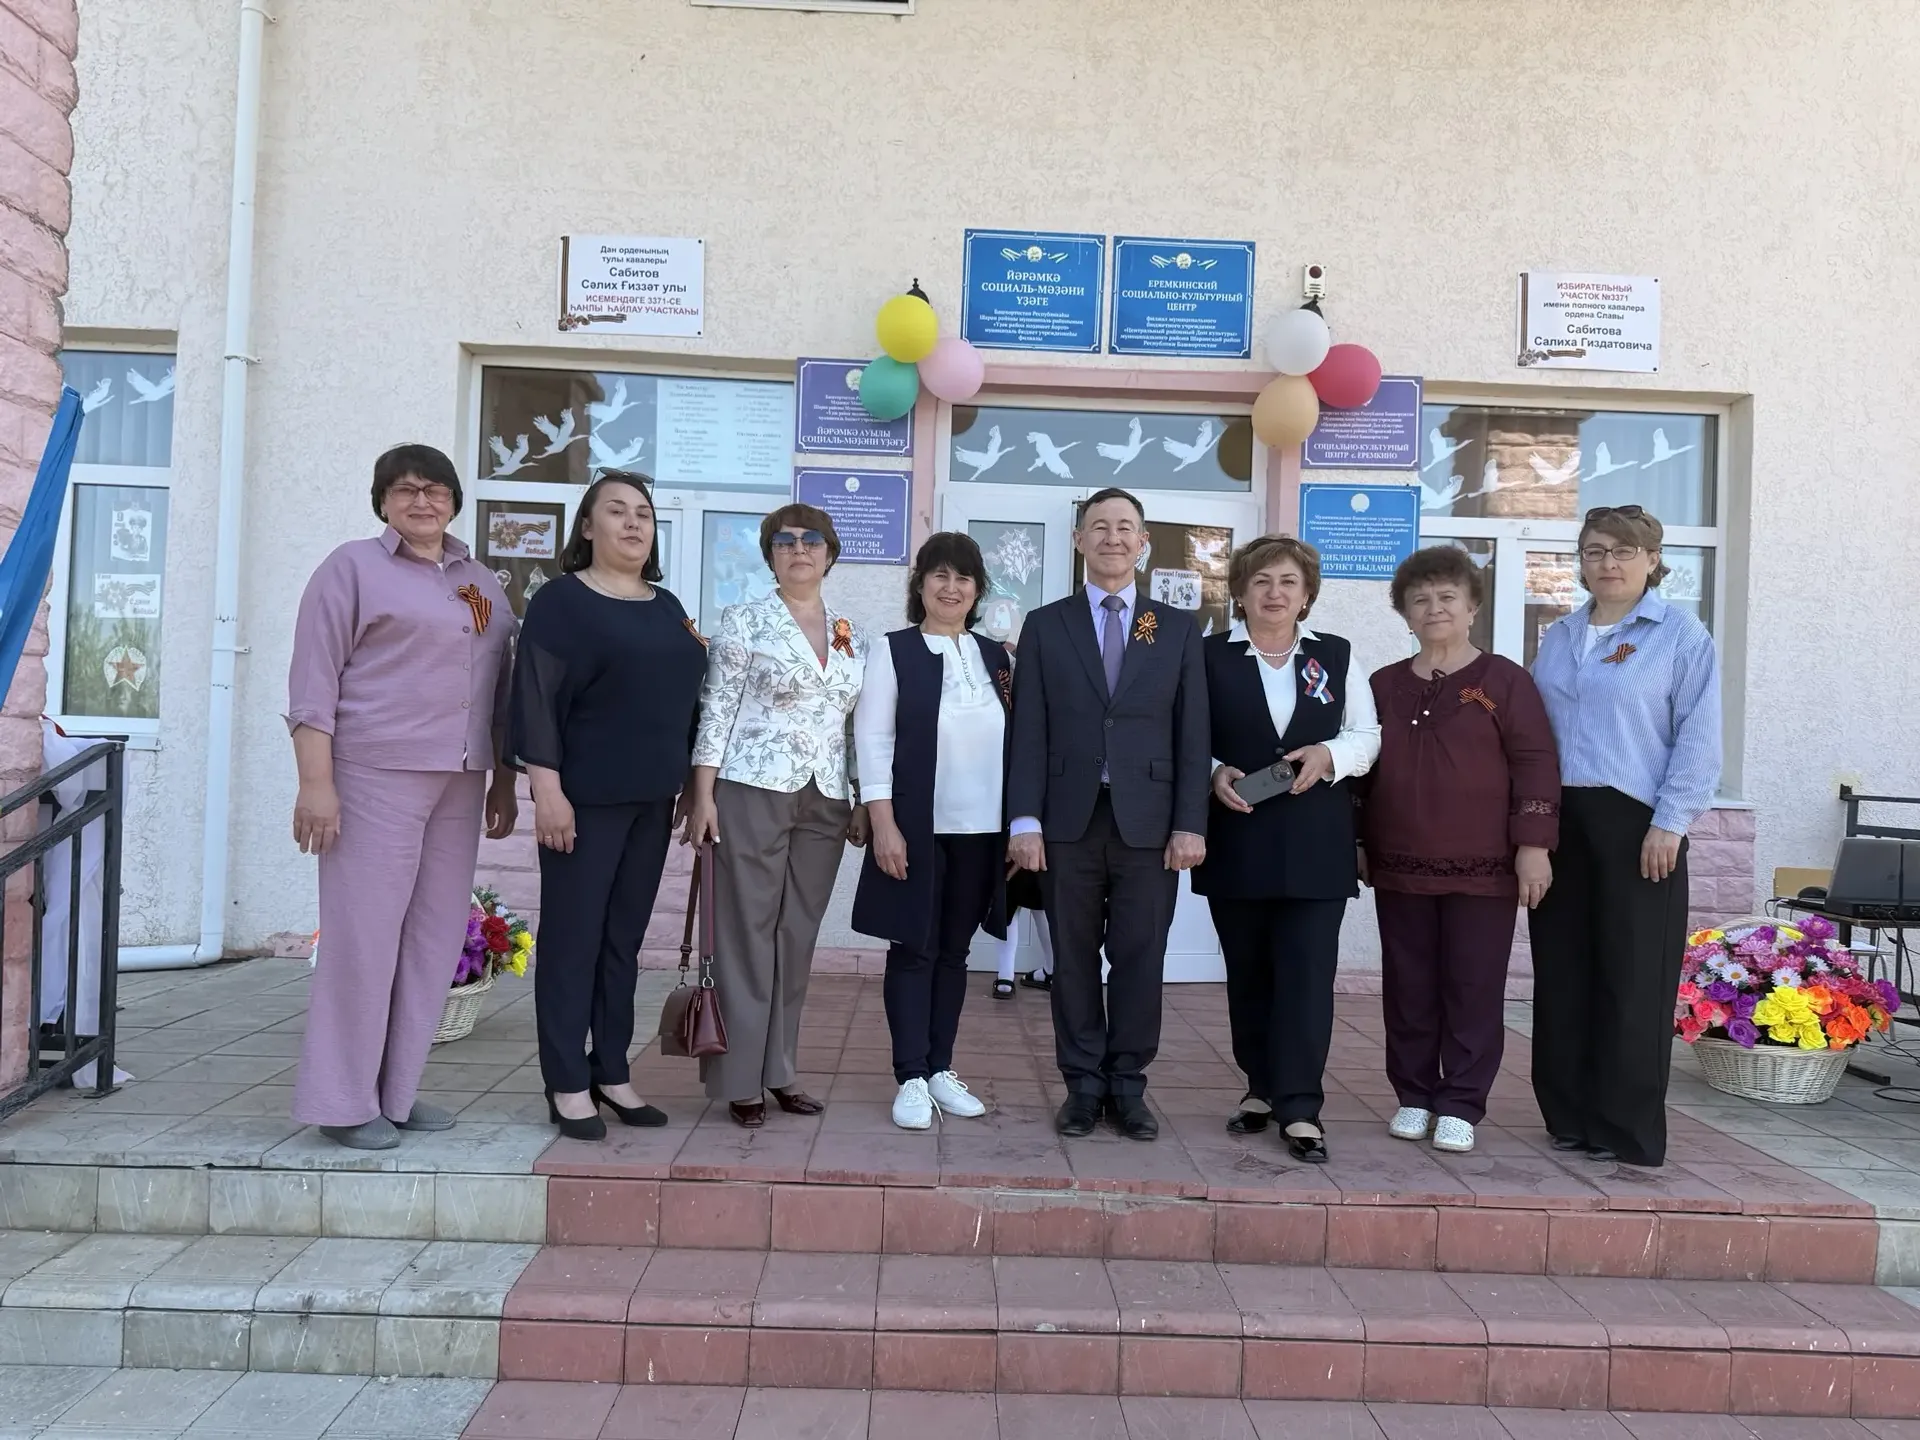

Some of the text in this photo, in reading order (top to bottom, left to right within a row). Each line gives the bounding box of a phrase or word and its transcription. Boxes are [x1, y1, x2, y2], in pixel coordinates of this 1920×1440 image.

[602, 256, 623, 264] тулы
[610, 267, 659, 278] Сабитов
[1007, 270, 1061, 282] ЙӘРӘМКӘ
[582, 280, 686, 294] Сәлих Ғиззәт улы
[981, 283, 1084, 296] СОЦИАЛЬ-МӘҘӘНИ
[1148, 280, 1217, 290] ЕРЕМКИНСКИЙ
[1557, 282, 1632, 292] ИЗБИРАТЕЛЬНЫЙ
[586, 295, 645, 304] ИСЕМЕНДӘГЕ
[1016, 296, 1048, 306] ҮҘӘГЕ
[1122, 290, 1242, 302] СОЦИАЛЬНО-КУЛЬТУРНЫЙ
[1560, 292, 1628, 301] УЧАСТОК №3371
[1167, 303, 1197, 312] ЦЕНТР
[1607, 304, 1645, 312] кавалера
[1596, 312, 1624, 320] Славы
[1567, 324, 1622, 336] Сабитова
[1534, 336, 1652, 350] Салиха Гиздатовича
[1314, 443, 1409, 451] СОЦИАЛЬНО-КУЛЬТУРНЫЙ
[1320, 554, 1396, 563] БИБЛИОТЕЧНЫЙ
[1356, 564, 1393, 572] ВЫДАЧИ
